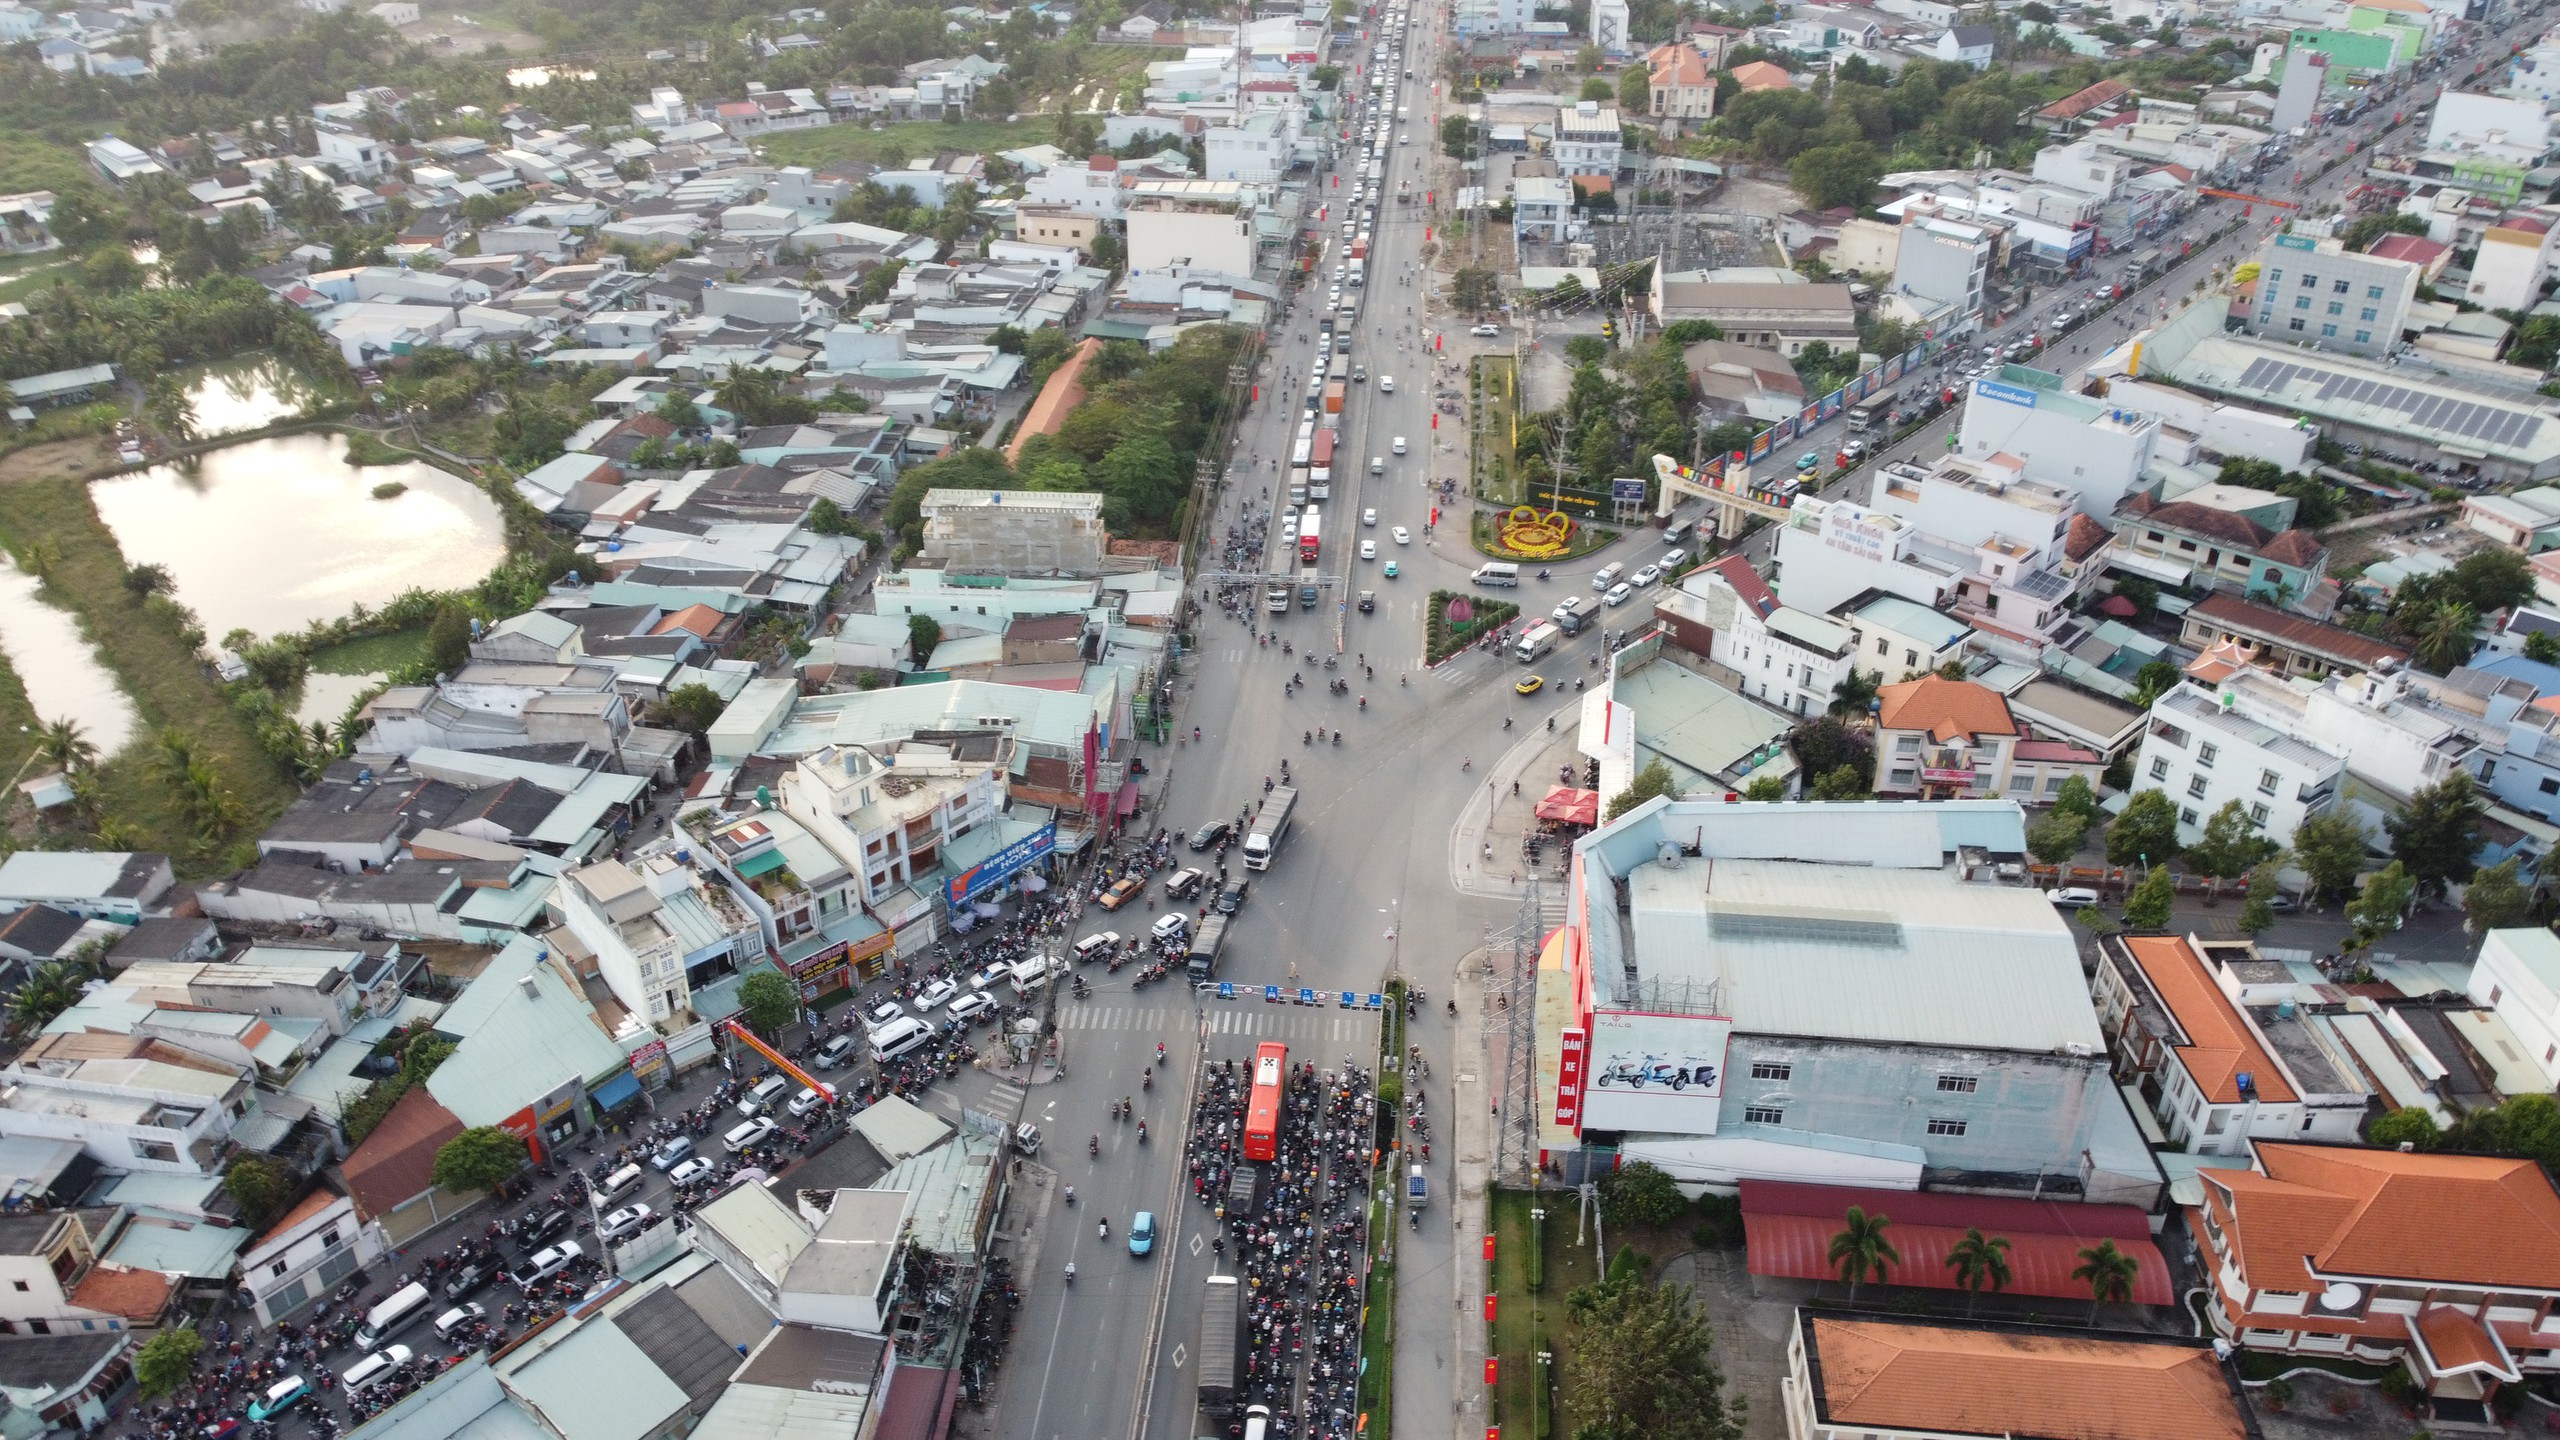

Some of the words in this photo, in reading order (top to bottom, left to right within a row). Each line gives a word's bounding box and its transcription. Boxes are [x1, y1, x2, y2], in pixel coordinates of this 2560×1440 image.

[1979, 384, 2033, 405] Sacombank
[1563, 1039, 1581, 1051] BÁN
[1565, 1061, 1576, 1072] XE
[1560, 1083, 1576, 1097] TRẢ
[1557, 1106, 1574, 1118] GÓP
